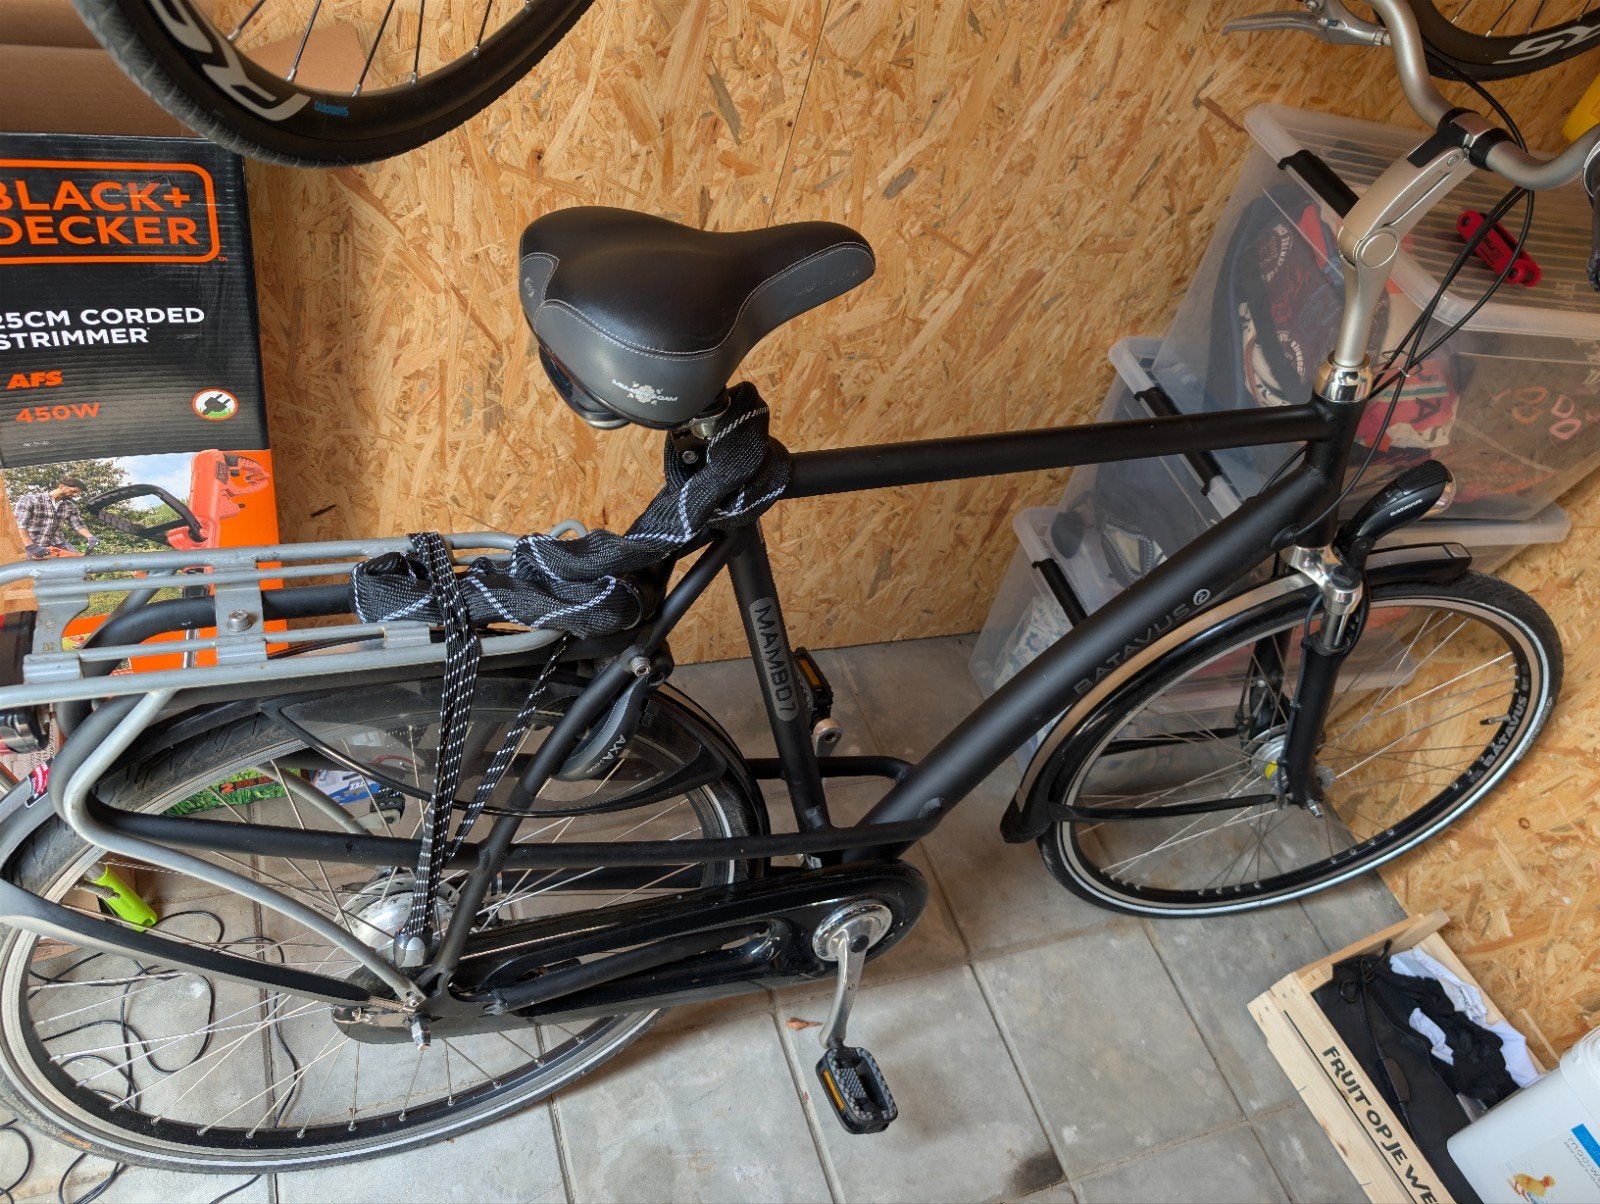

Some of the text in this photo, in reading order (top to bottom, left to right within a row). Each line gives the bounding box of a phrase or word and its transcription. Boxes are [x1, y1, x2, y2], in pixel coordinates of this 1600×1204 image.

[0, 215, 199, 245] DECKER
[0, 307, 205, 329] 5CM CORDED
[0, 327, 148, 350] STRIMMER
[6, 370, 64, 390] AFS
[15, 402, 100, 423] 450W
[1073, 603, 1190, 695] BATAVUS
[1482, 694, 1528, 767] BATAVUS
[602, 734, 626, 760] AXA
[1322, 1046, 1440, 1204] FRUIT OP JE WE
